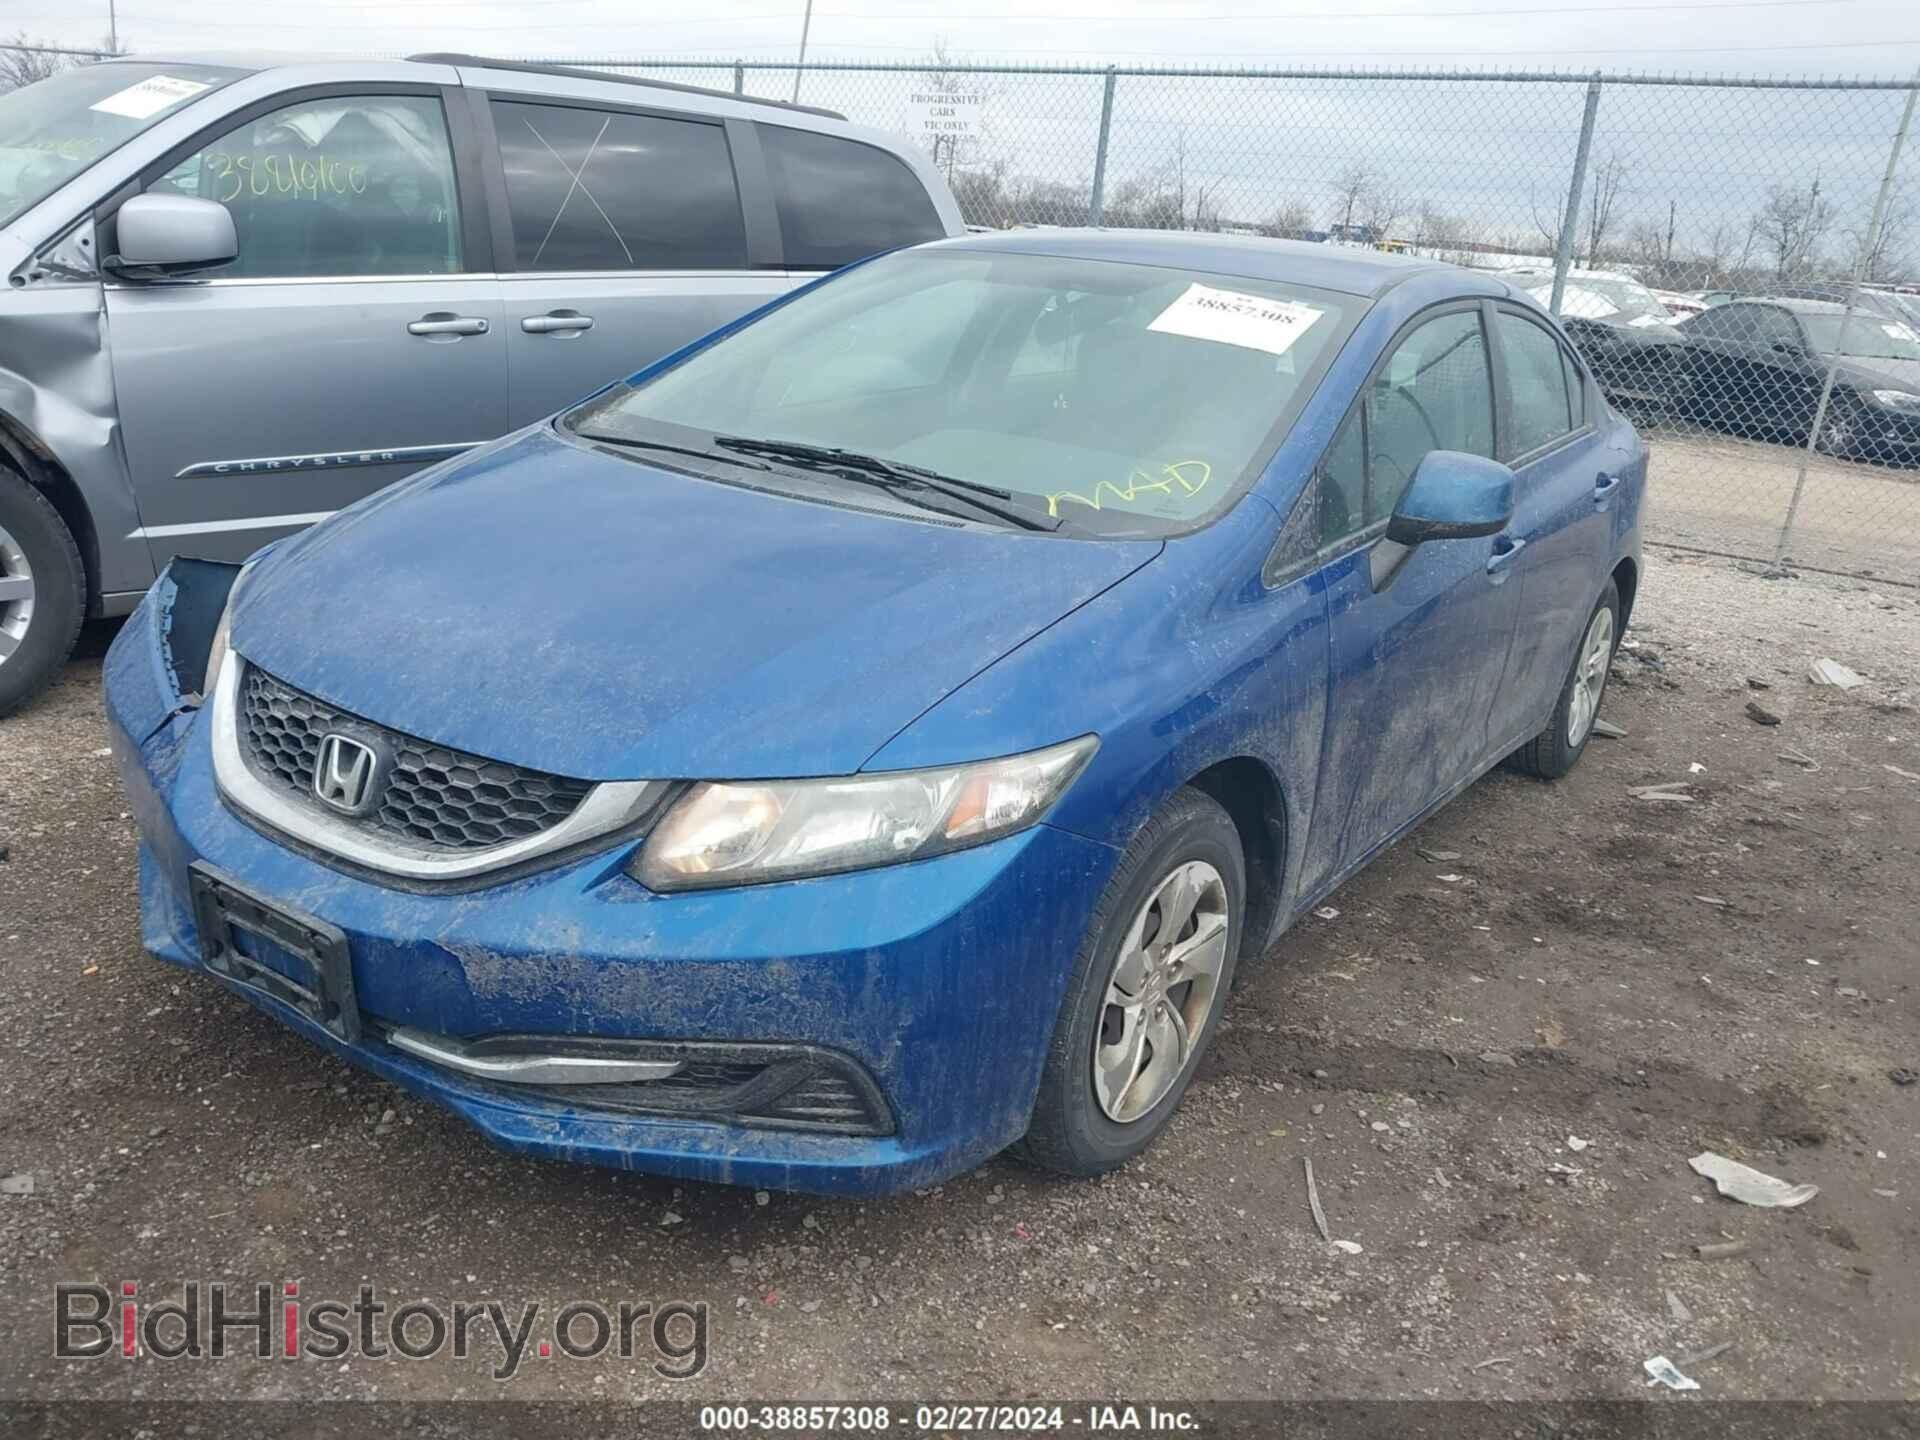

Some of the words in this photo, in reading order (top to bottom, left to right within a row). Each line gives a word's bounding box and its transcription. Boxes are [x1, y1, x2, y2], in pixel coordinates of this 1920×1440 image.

[911, 94, 981, 105] PROGRESSIVE
[929, 107, 957, 117] CARS
[924, 120, 943, 130] VIC
[943, 121, 969, 131] ONLY
[214, 452, 396, 473] CHRYSLER
